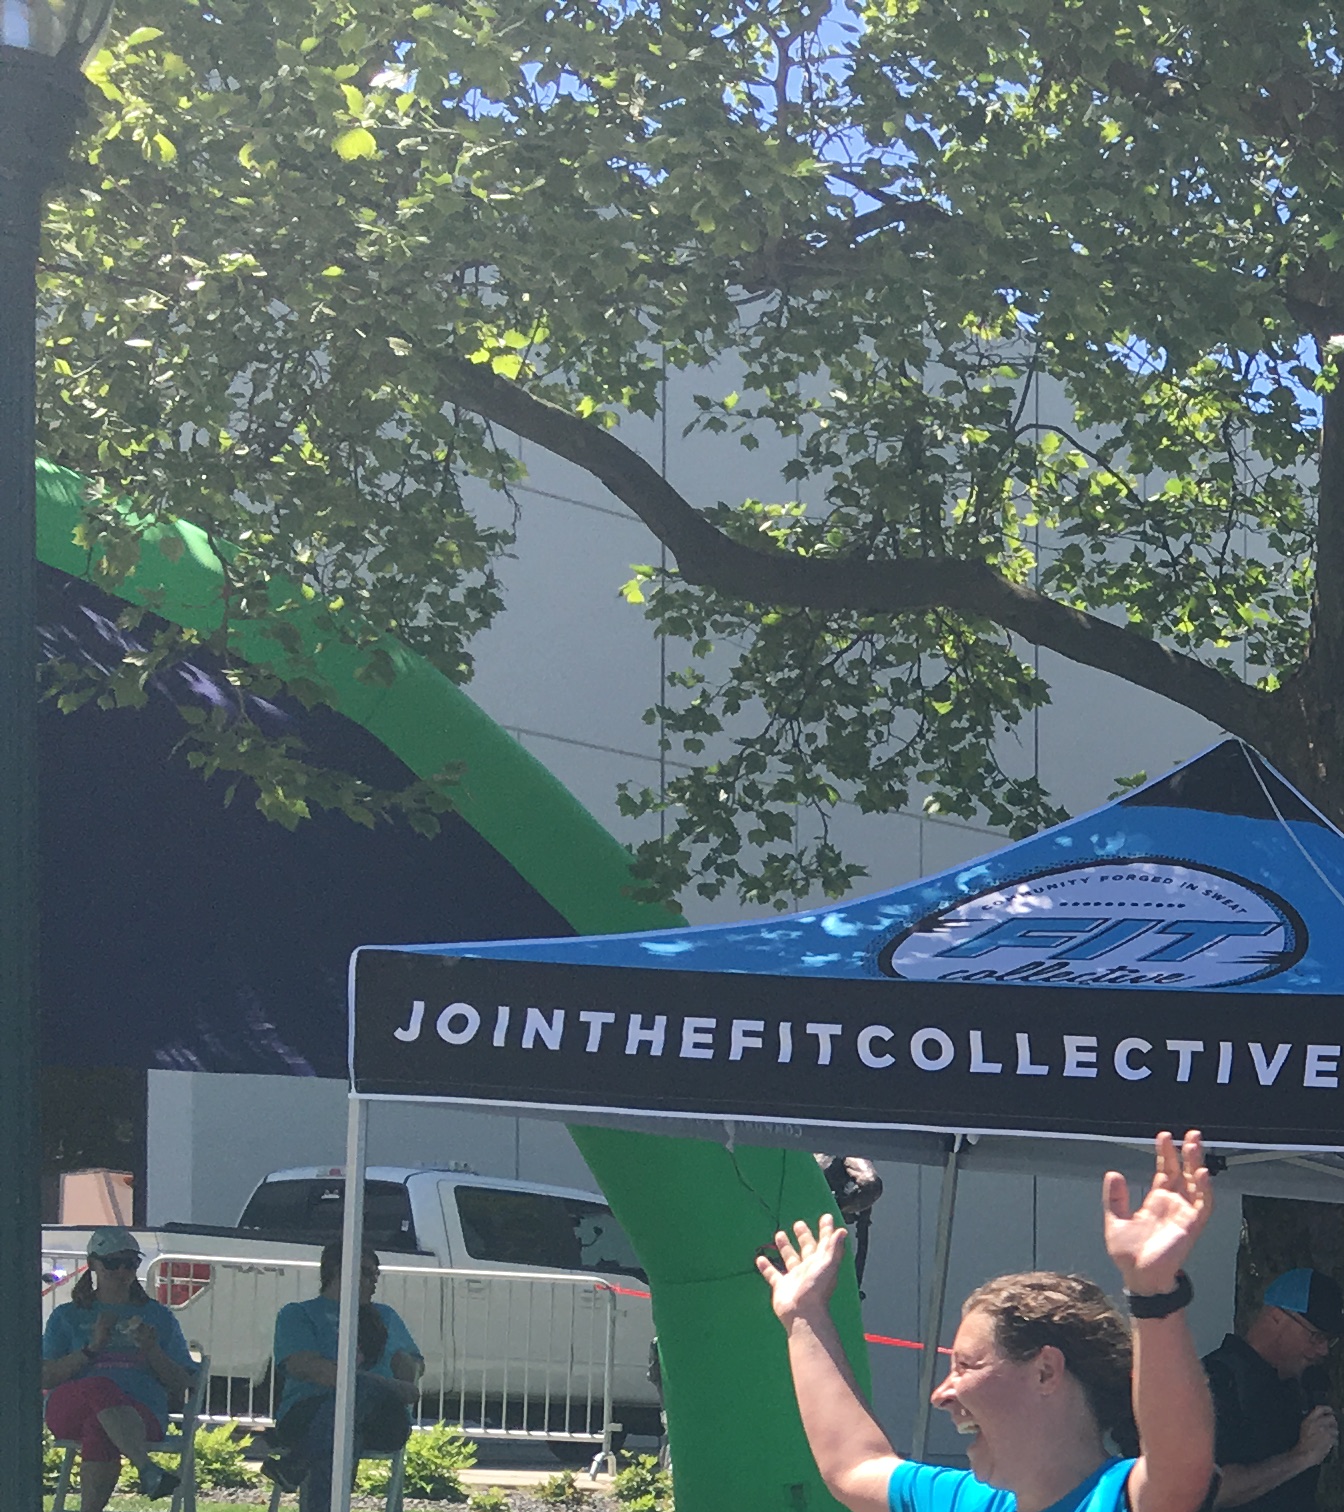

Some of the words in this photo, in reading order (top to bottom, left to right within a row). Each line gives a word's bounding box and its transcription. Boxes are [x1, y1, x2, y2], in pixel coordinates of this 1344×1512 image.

[1100, 873, 1174, 885] FORGED
[1180, 881, 1198, 891] IN
[1202, 889, 1248, 914] SWEAT
[933, 917, 1283, 963] FIT
[937, 961, 1197, 985] collective
